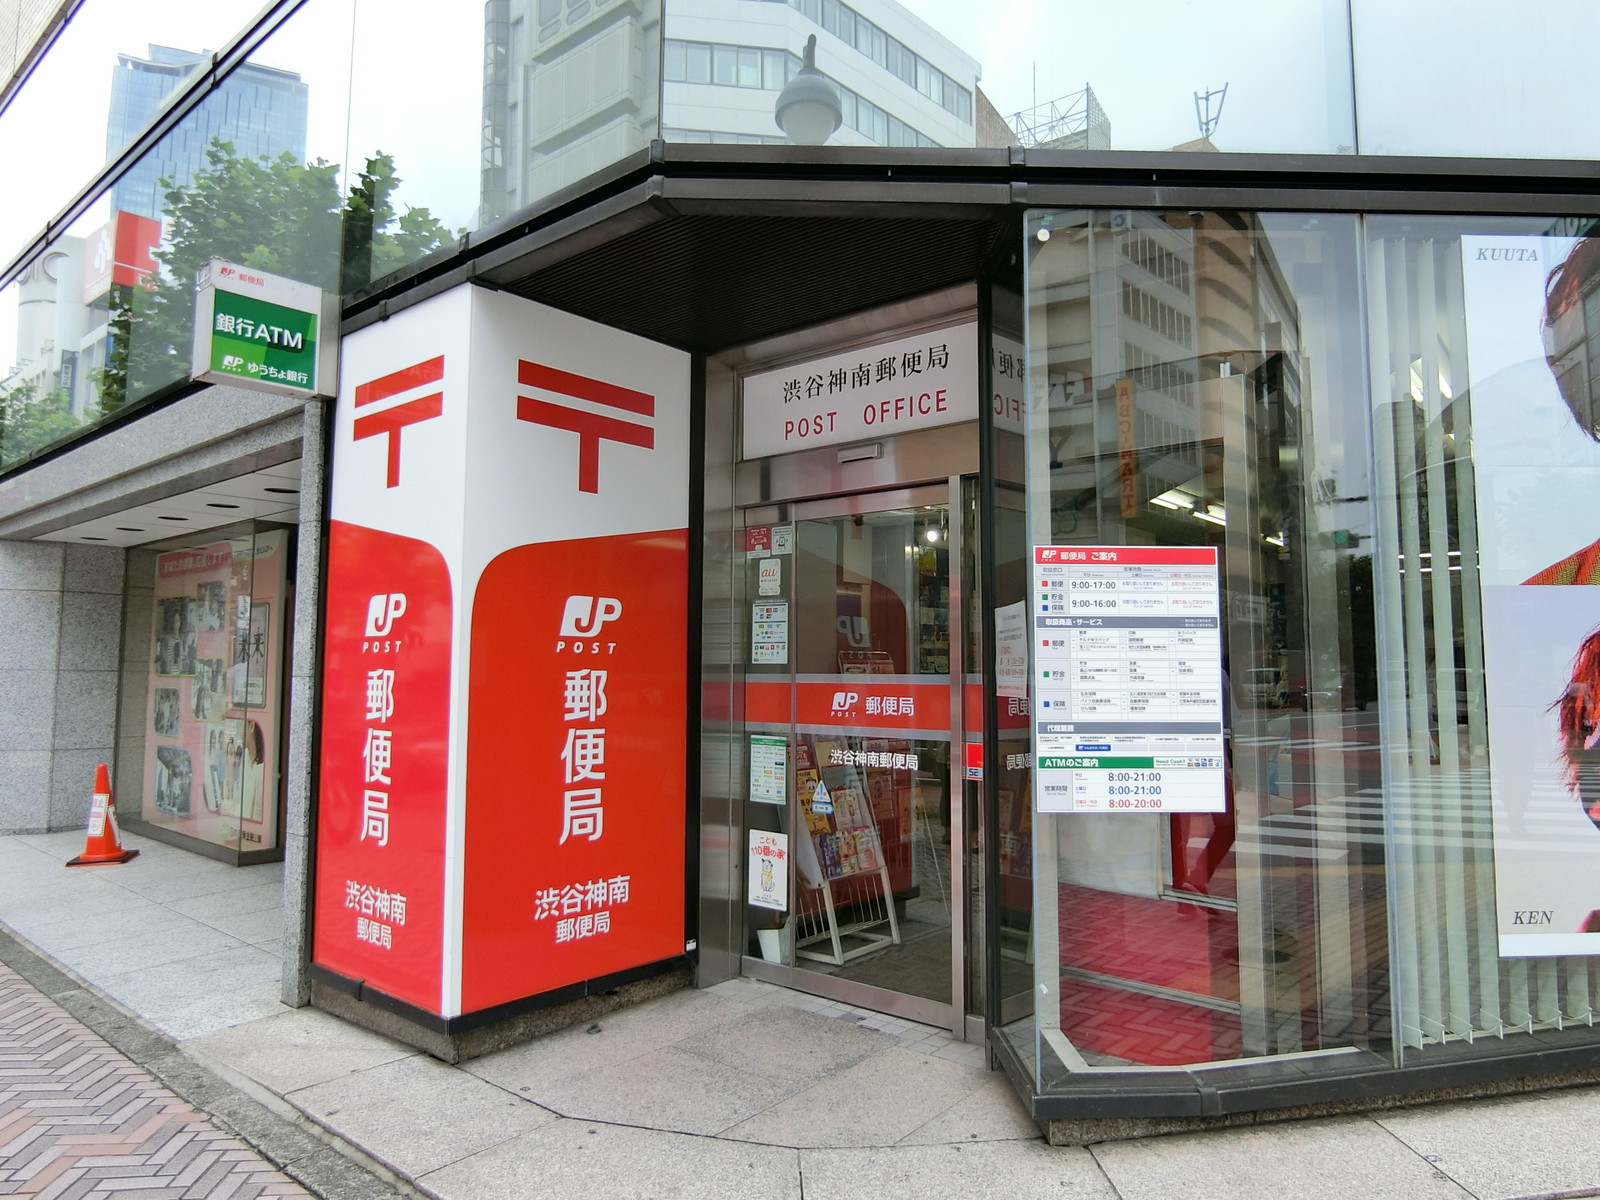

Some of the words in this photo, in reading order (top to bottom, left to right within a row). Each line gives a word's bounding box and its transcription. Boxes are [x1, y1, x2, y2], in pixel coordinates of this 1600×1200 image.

[1476, 247, 1538, 262] KUUTA
[239, 273, 265, 287] 郵便局
[215, 312, 303, 350] 銀行ATM
[223, 354, 244, 368] JP
[247, 362, 309, 384] ゆうちょ銀行
[783, 343, 949, 404] 渋谷神南郵便局
[785, 411, 838, 441] POST
[863, 389, 948, 426] OFFICE
[1041, 550, 1057, 559] JP
[1060, 552, 1086, 561] 郵便局
[1091, 551, 1117, 561] ご案内
[761, 568, 777, 578] au
[1071, 581, 1116, 589] 9:00-17:00
[1072, 600, 1117, 608] 9:00-16:00
[365, 593, 407, 637] JP
[559, 595, 623, 638] JP
[362, 641, 403, 653] POST
[556, 641, 618, 655] POST
[832, 692, 859, 711] JP
[865, 696, 915, 717] 郵便局
[360, 668, 395, 847] 郵便局
[559, 668, 608, 846] 郵便局
[830, 749, 919, 772] 渋谷神南郵便局
[1044, 758, 1099, 768] ATMのご案内
[1108, 772, 1161, 782] 8:00-21:00
[1108, 785, 1162, 795] 8:00-21:00
[1109, 799, 1162, 808] 8:00-20:00
[760, 836, 777, 846] こども
[751, 845, 786, 860] 110番の家
[345, 879, 407, 926] 渋谷神南
[534, 874, 631, 921] 渋谷神南
[1512, 910, 1554, 925] KEN
[356, 916, 393, 950] 郵便局
[555, 910, 611, 944] 郵便局
